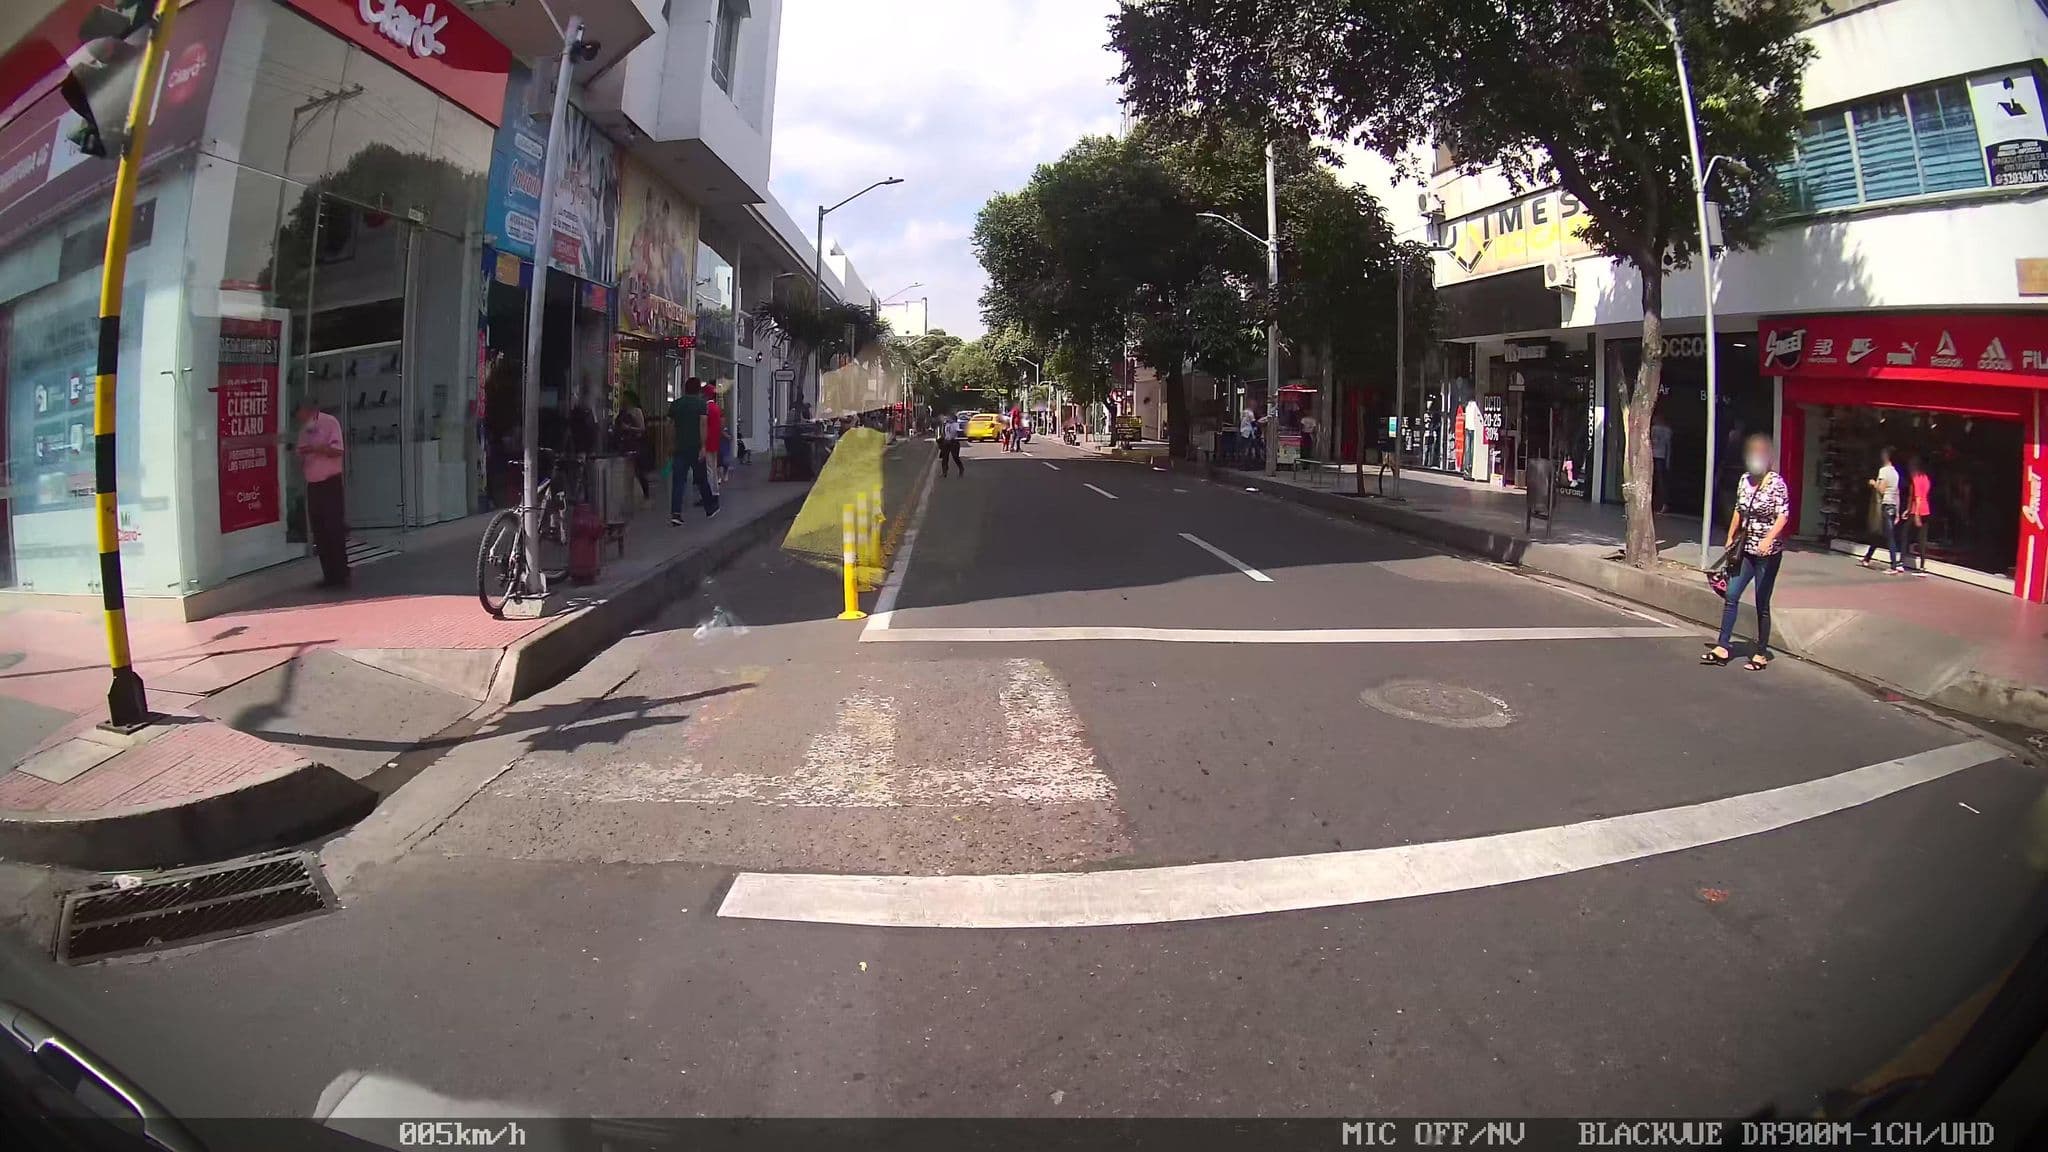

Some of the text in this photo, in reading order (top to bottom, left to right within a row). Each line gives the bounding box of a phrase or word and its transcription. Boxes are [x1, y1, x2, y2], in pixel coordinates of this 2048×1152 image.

[2023, 350, 2048, 370] FIL
[227, 397, 268, 417] CLIENTE
[231, 416, 264, 436] CLARO
[1485, 427, 1499, 441] 30%
